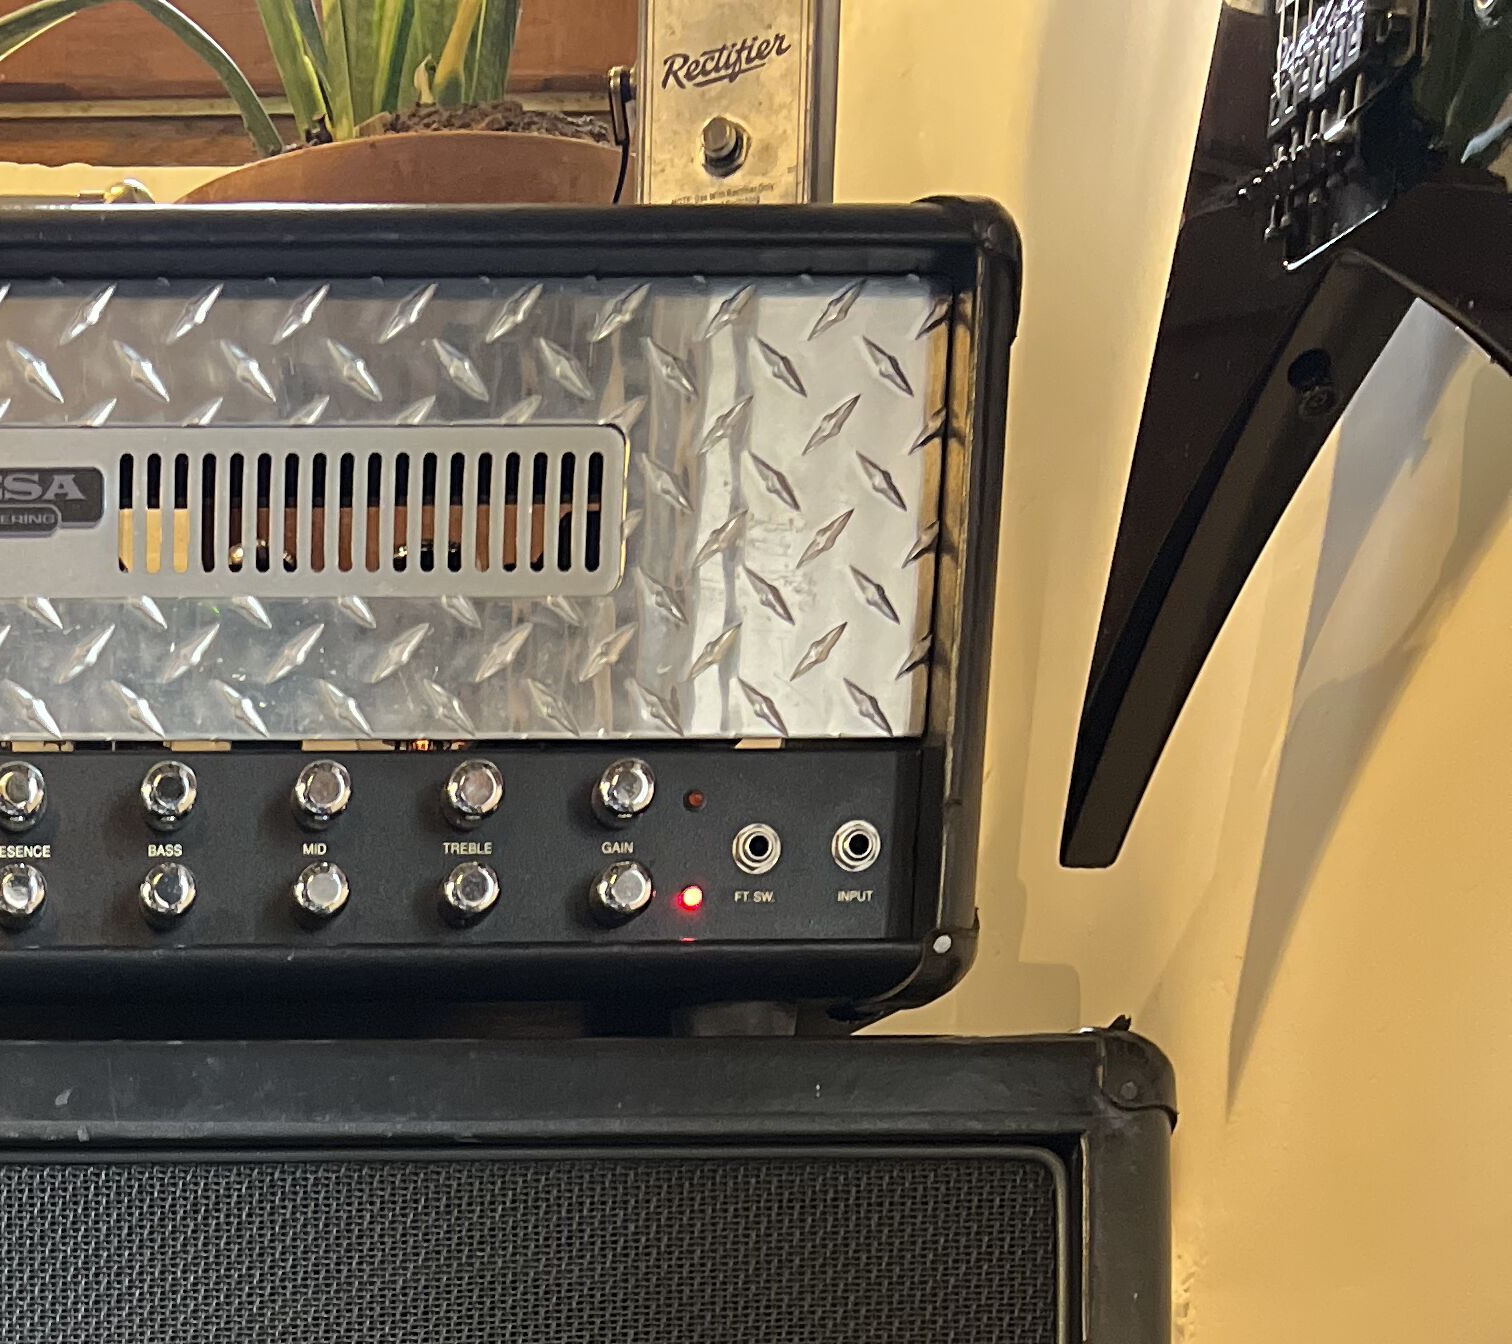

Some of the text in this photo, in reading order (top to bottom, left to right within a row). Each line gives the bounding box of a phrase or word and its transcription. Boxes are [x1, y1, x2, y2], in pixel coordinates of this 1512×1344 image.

[661, 33, 792, 90] Rectifier
[147, 845, 183, 858] BASS
[302, 843, 327, 856] MID
[443, 842, 493, 855] TREBLE
[601, 841, 634, 854] GAIN
[734, 891, 750, 903] FT
[837, 890, 873, 903] INPUT
